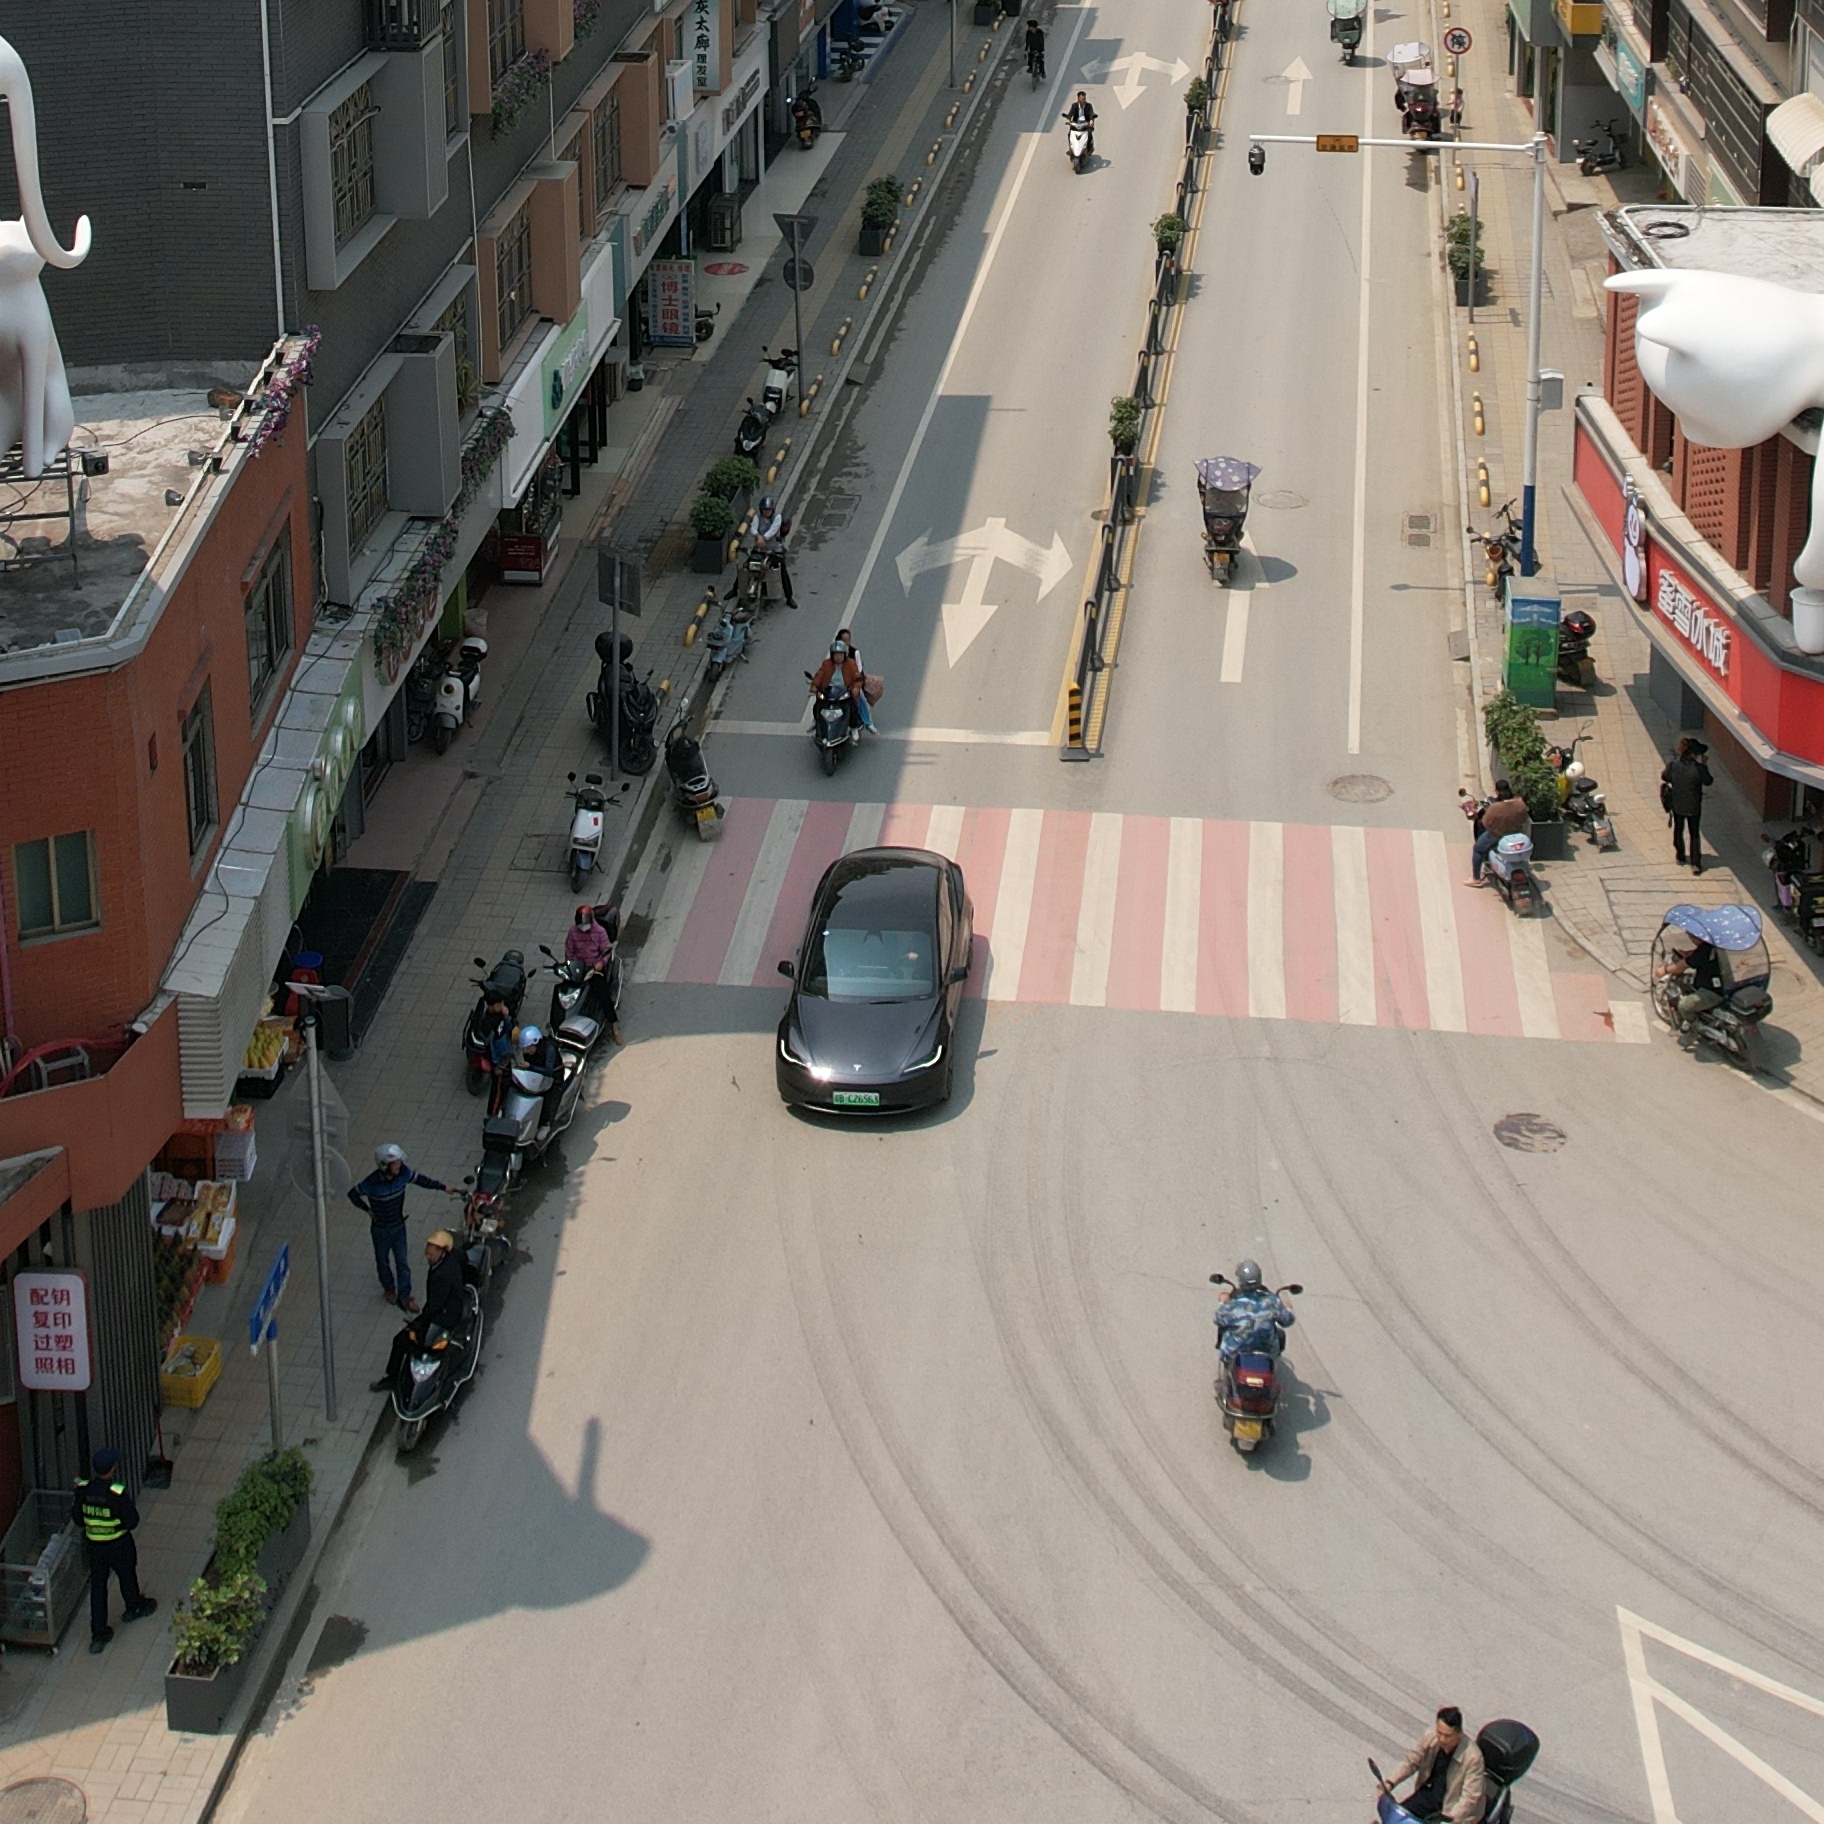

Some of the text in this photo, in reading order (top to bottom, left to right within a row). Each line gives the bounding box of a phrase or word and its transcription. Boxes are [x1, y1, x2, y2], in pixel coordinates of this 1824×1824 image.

[661, 280, 680, 335] 博士眼镜
[1658, 568, 1731, 677] 蜜雪冰城
[29, 1288, 71, 1306] 配钥
[33, 1310, 72, 1329] 复印
[34, 1333, 75, 1352] 过塑
[35, 1356, 76, 1375] 照相
